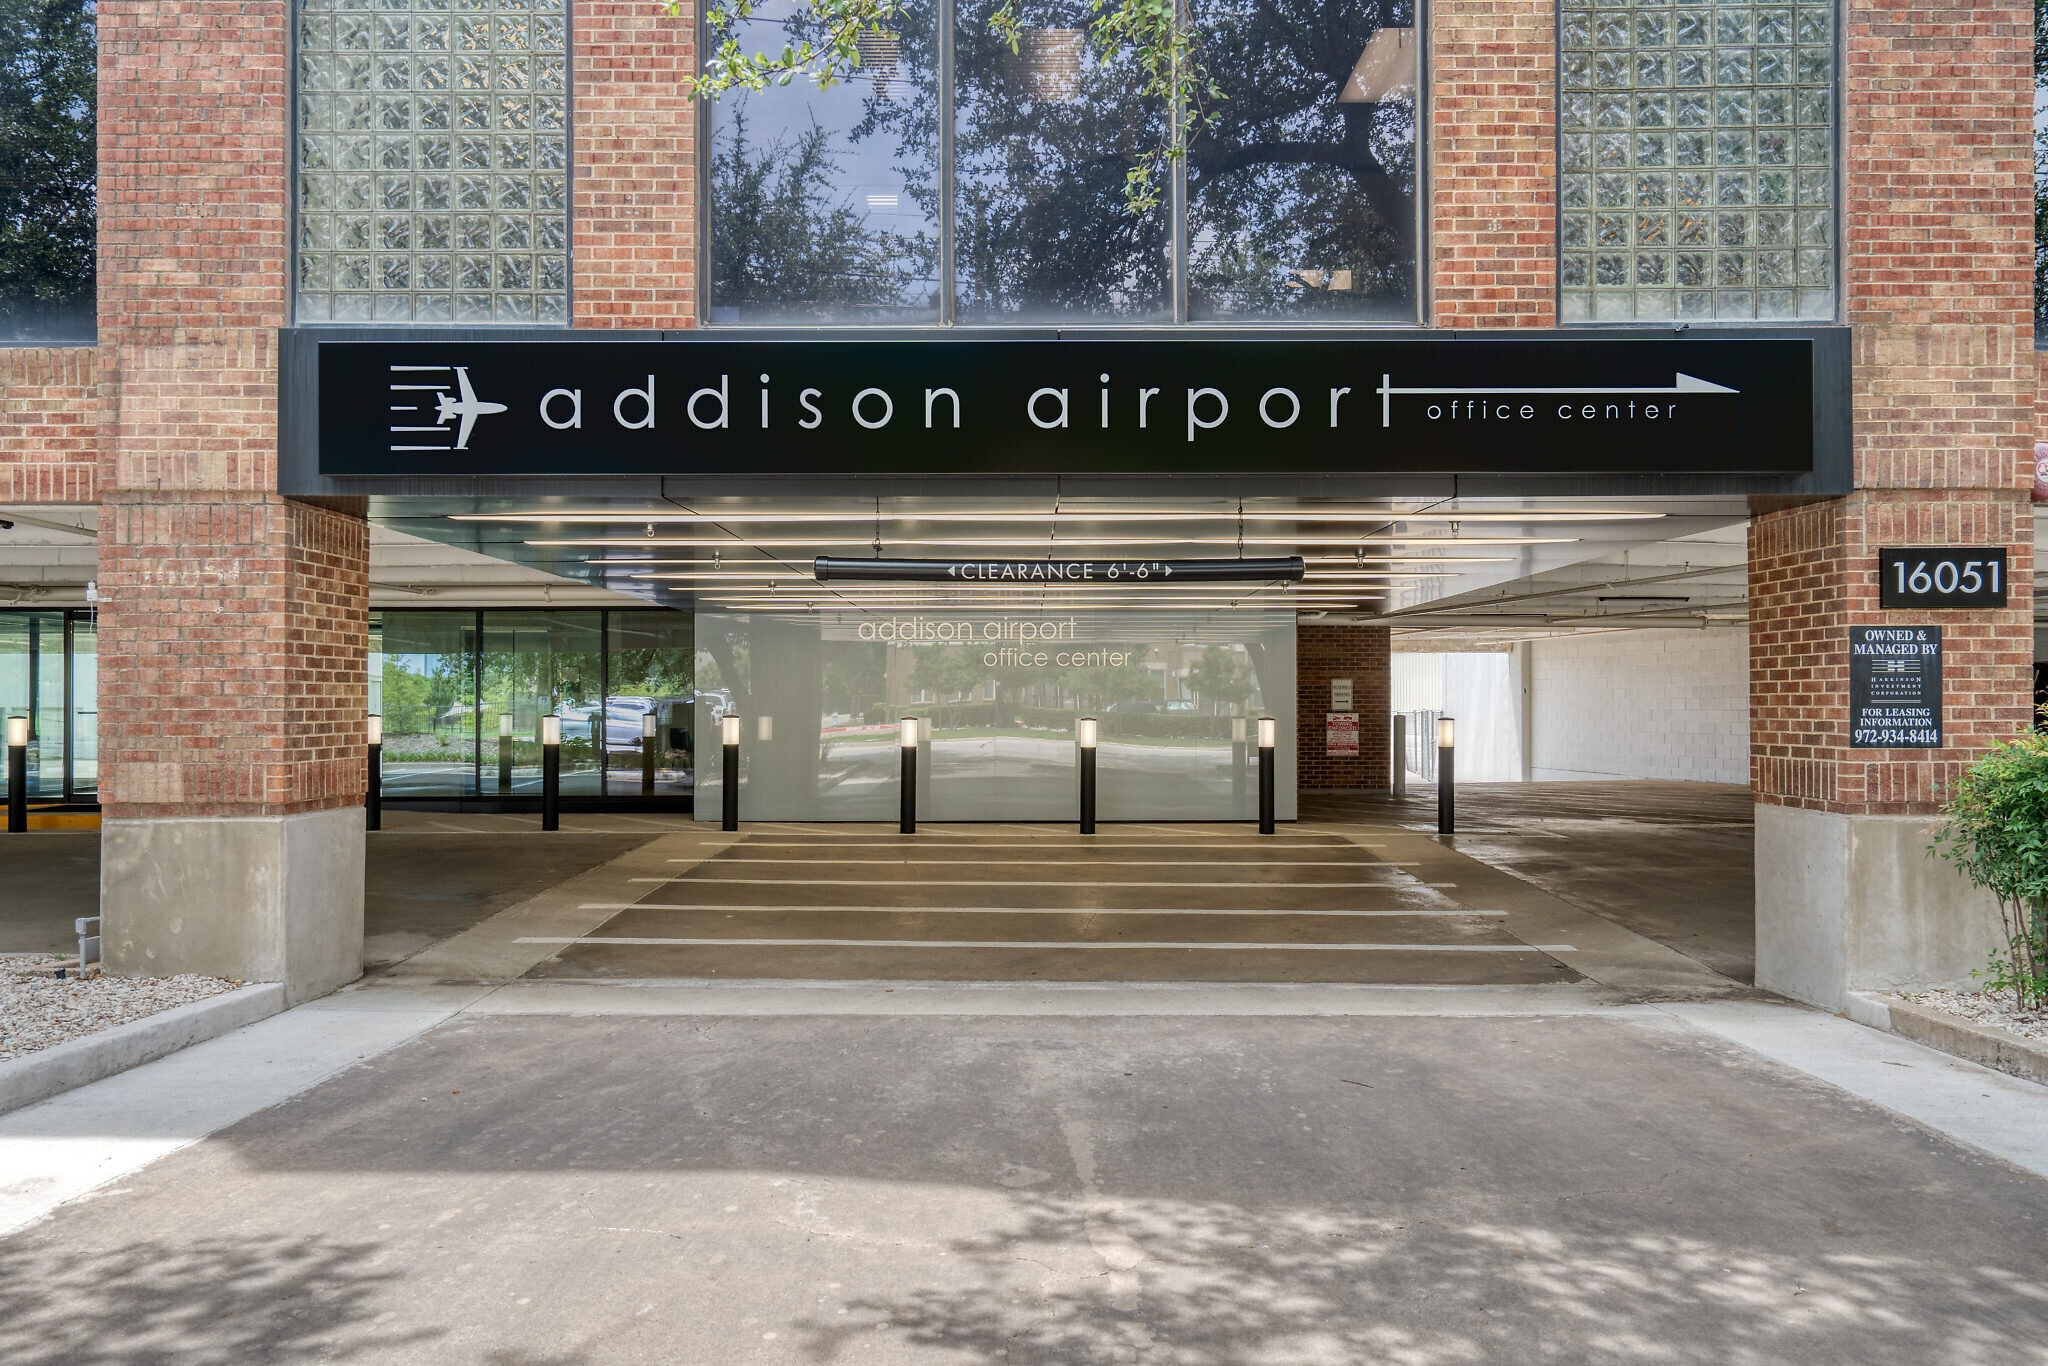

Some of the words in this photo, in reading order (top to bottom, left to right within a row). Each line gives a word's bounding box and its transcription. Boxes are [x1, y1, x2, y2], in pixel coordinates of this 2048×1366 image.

[540, 373, 960, 430] addison
[1027, 373, 1392, 442] airport
[1427, 400, 1534, 420] office
[1558, 400, 1677, 420] center
[961, 563, 1094, 580] CLEARANCE
[1107, 562, 1160, 580] 6'-6"
[1893, 561, 2000, 594] 16051
[858, 617, 973, 640] addison
[983, 616, 1077, 646] airport
[1865, 630, 1914, 641] OWNED
[1916, 630, 1928, 641] &
[983, 648, 1048, 667] office
[1055, 648, 1132, 667] center
[1854, 644, 1919, 655] MANAGED
[1921, 644, 1938, 655] BY
[1862, 708, 1882, 717] FOR
[1885, 708, 1931, 717] LEASING
[1860, 718, 1932, 727] INFORMATION
[1855, 729, 1938, 743] 972-934-8414
